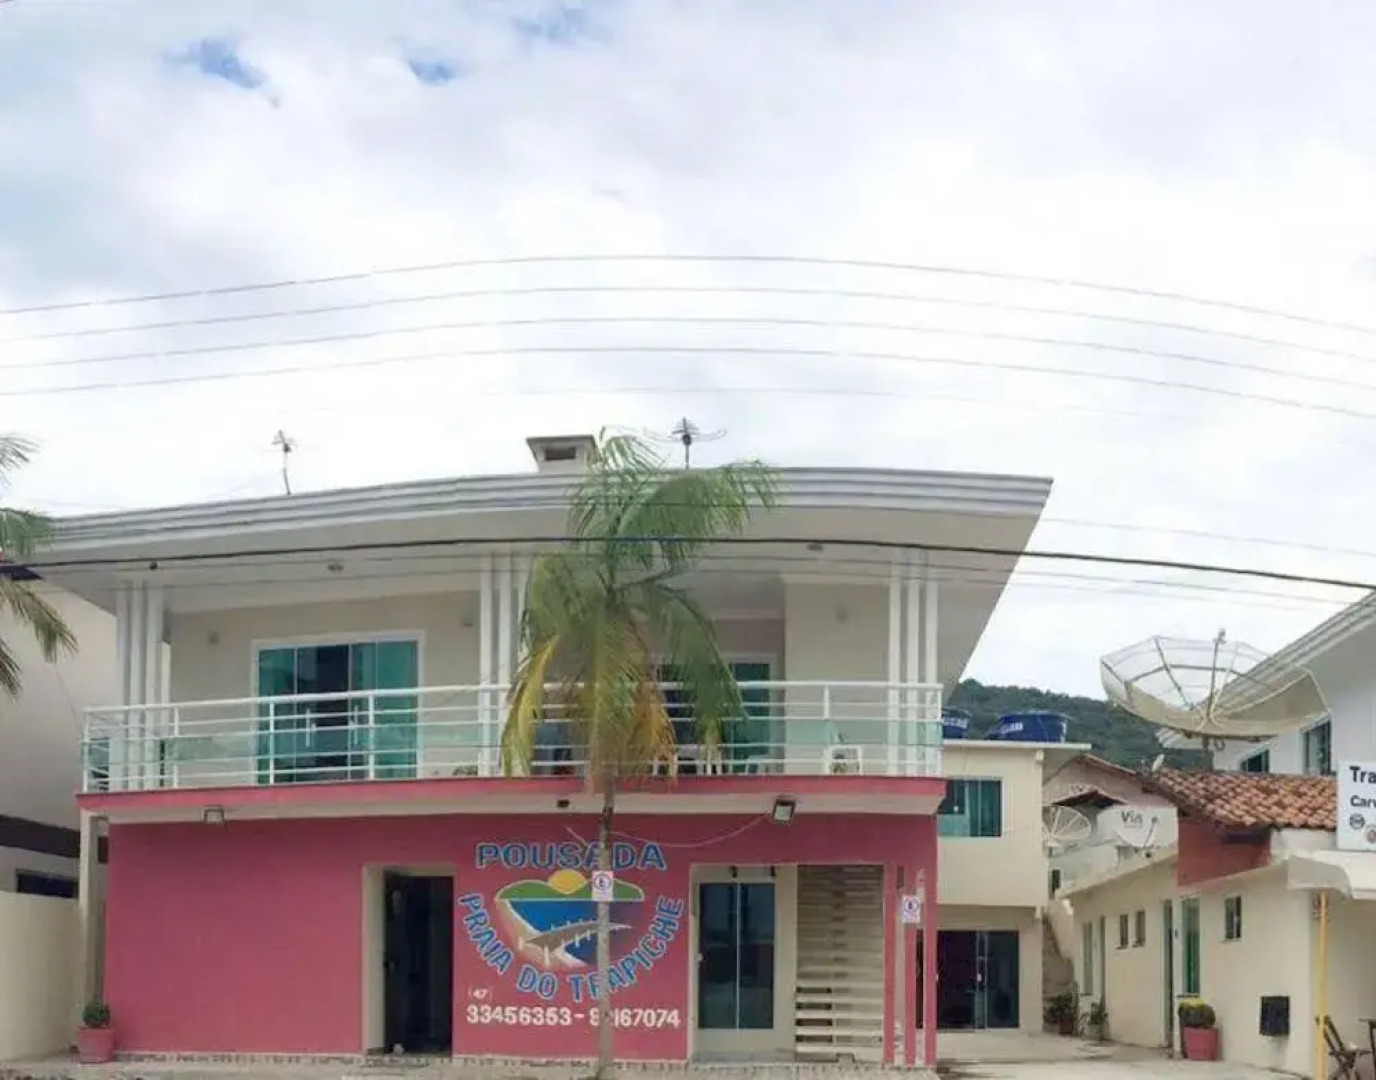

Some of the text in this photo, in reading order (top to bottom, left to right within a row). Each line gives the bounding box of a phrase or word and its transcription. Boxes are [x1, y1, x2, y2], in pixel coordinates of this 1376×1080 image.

[475, 841, 667, 870] POUSADA
[460, 892, 514, 975] PRAIA
[517, 964, 559, 1000] DO
[466, 1003, 572, 1027] 33456353
[589, 1007, 682, 1028] 9167074
